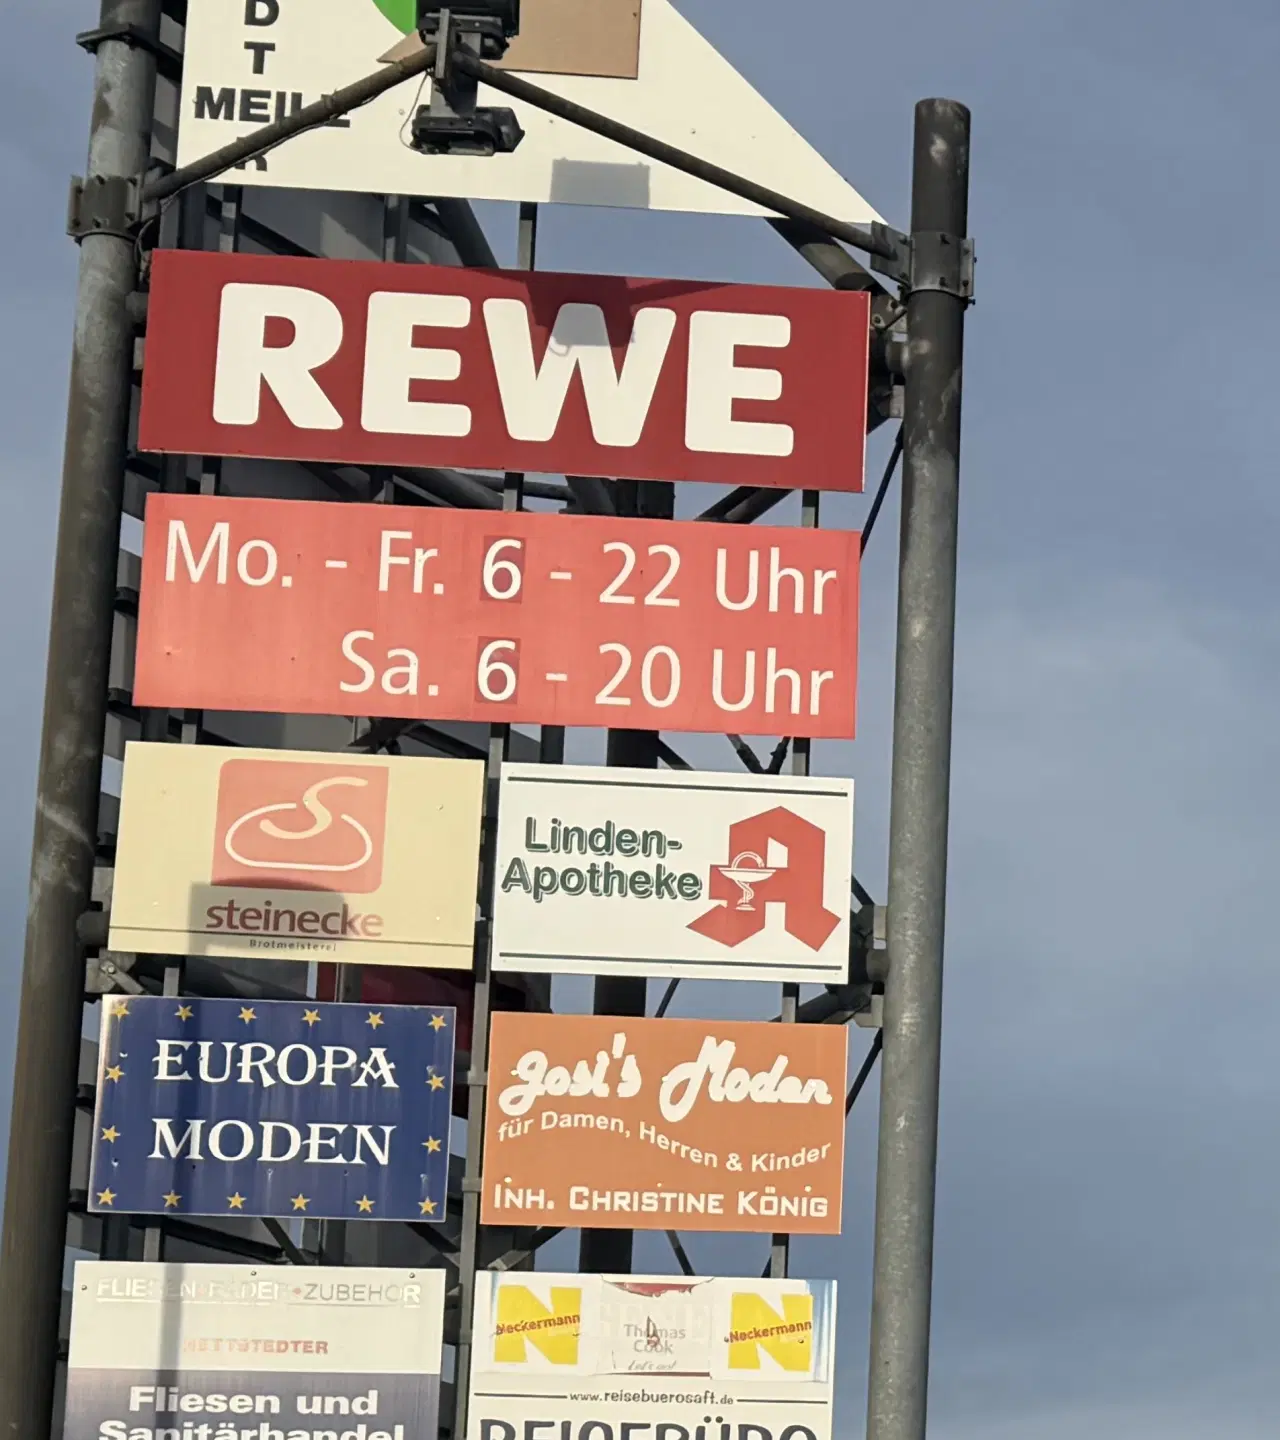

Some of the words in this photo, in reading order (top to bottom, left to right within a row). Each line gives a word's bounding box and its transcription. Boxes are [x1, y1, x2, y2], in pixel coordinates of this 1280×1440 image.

[194, 86, 350, 128] MEIL
[212, 282, 796, 457] REWE
[166, 520, 294, 589] Mo.
[378, 530, 445, 596] Fr.
[482, 538, 523, 601] 6
[599, 542, 681, 608] 22
[715, 546, 837, 616] Uhr
[340, 630, 439, 697] Sa.
[476, 639, 517, 701] 6
[594, 643, 681, 708] 20
[710, 648, 834, 716] Uhr
[524, 816, 683, 859] Linden-
[501, 858, 703, 903] Apotheke
[205, 898, 384, 937] steinecke
[152, 1038, 400, 1090] EUROPA
[148, 1119, 397, 1166] MODEN
[497, 1117, 535, 1142] für
[541, 1111, 632, 1138] Damen,
[639, 1121, 718, 1168] Herren
[725, 1153, 743, 1172] &
[751, 1142, 832, 1172] Kinder
[569, 1186, 724, 1215] CHRISTINE
[737, 1186, 829, 1218] KÖNIG
[728, 1320, 813, 1344] Neckermann
[128, 1385, 281, 1415] Fliesen
[295, 1389, 379, 1416] und
[569, 1389, 735, 1406] www.reisebuerosaft.de
